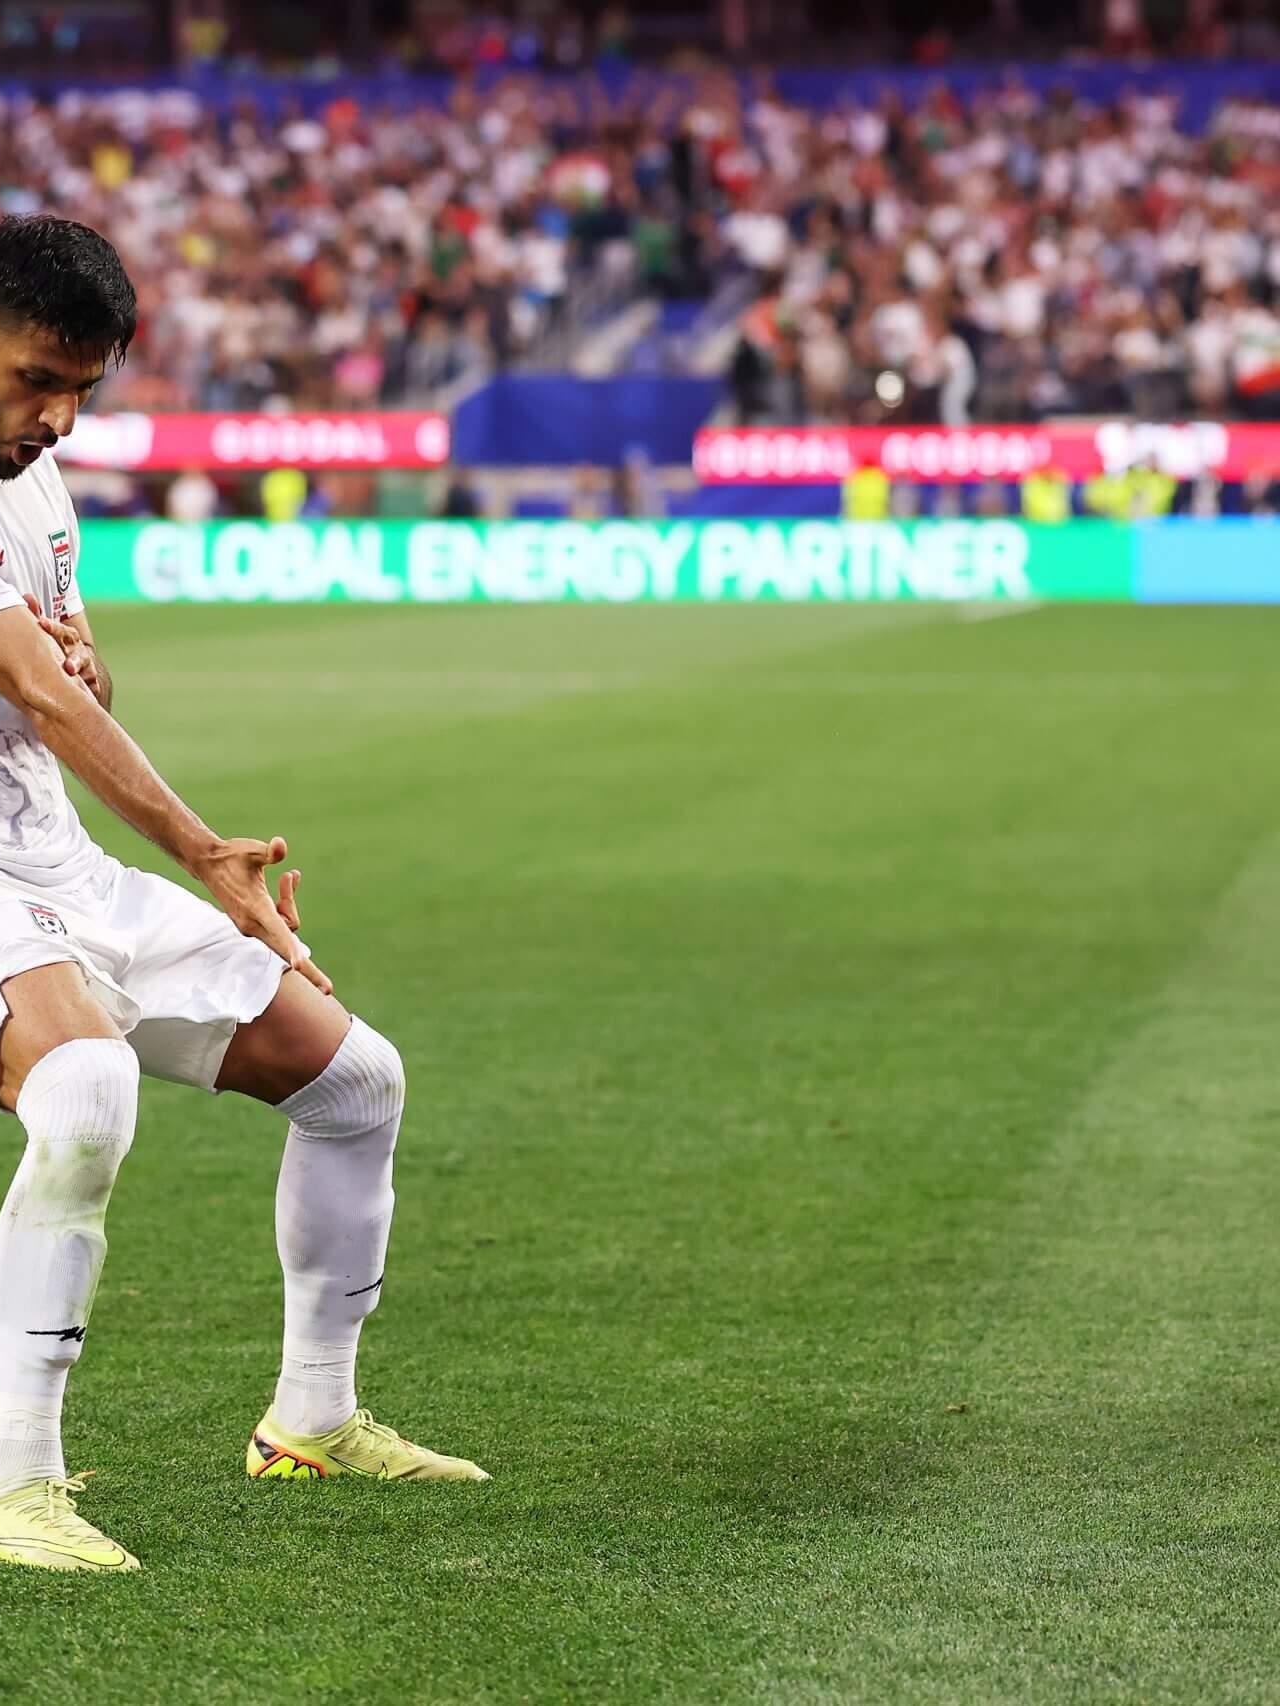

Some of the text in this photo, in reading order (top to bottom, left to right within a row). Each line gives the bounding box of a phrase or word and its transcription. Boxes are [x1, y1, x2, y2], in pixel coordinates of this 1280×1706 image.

[134, 521, 1031, 600] GLOBAL ENERGY PARTNER
